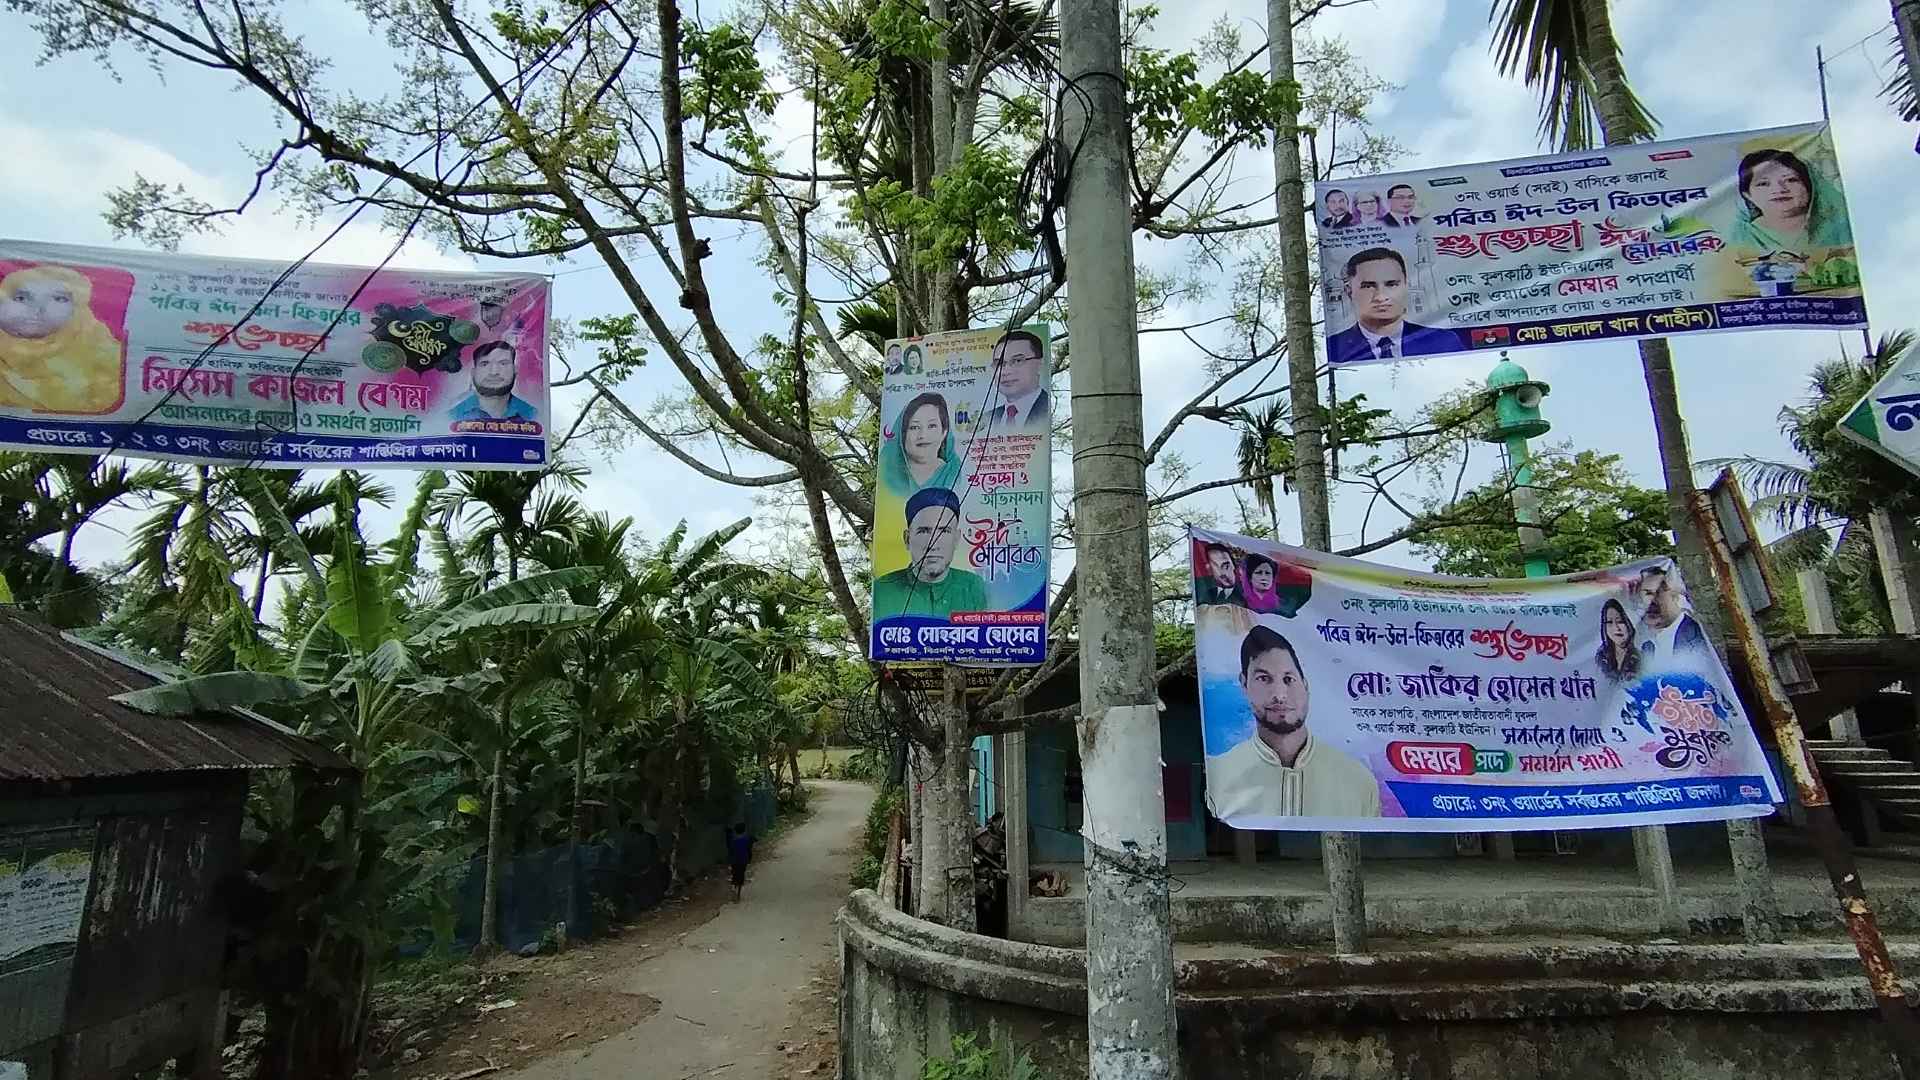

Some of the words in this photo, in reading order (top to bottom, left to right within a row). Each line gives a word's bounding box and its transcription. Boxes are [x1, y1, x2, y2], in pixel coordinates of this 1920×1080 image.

[1455, 191, 1481, 203] ৩নং
[1486, 183, 1521, 200] ওয়ার্ড
[1525, 179, 1569, 197] (সরই)
[1625, 168, 1669, 182] জানাই
[1433, 207, 1497, 228] পবিত্র
[1608, 187, 1709, 211] ফিতরের
[1433, 219, 1585, 260] শুভেচ্ছা
[1621, 236, 1727, 265] মোবারক
[1445, 273, 1476, 288] ৩নং
[1478, 264, 1534, 286] কুলকাঠি
[1537, 257, 1616, 278] ইউনিয়নের
[149, 293, 201, 314] পবিত্র
[1448, 292, 1482, 307] ৩নং
[1488, 280, 1553, 302] ওয়ার্ডের
[1558, 274, 1619, 297] মেম্বার
[1495, 303, 1558, 320] আপনাদের
[1562, 299, 1595, 314] দোয়া
[1600, 299, 1612, 309] ও
[1615, 291, 1655, 307] সমর্থন
[1516, 326, 1549, 342] মোঃ
[1550, 320, 1604, 338] জালাল
[1608, 317, 1640, 333] খান
[1645, 307, 1714, 335] (শাহীন)
[246, 371, 346, 406] কাজল
[357, 382, 431, 414] বেগম
[299, 415, 313, 428] ও
[316, 410, 367, 433] সমর্থন
[152, 434, 170, 448] ও
[174, 435, 212, 454] ৩নং
[967, 471, 1015, 494] শুভেচ্ছা
[980, 485, 1043, 510] অভিনন্দন
[968, 541, 1044, 581] মোবারক
[1341, 598, 1365, 612] ৩নং
[1368, 596, 1409, 615] কুলকাঠি
[880, 626, 912, 647] মোঃ
[917, 626, 981, 647] সোহরাব
[986, 626, 1041, 647] হোসেন
[1316, 618, 1351, 645] পবিত্র
[1469, 619, 1569, 662] শুভেচ্ছা
[1395, 665, 1482, 702] জাকির
[1487, 675, 1556, 703] হোসেন
[1501, 724, 1566, 749] সকলের
[1569, 724, 1607, 747] দোয়া
[1611, 726, 1628, 743] ও
[1400, 746, 1462, 773] মেম্বার
[1474, 751, 1506, 771] পদে
[1518, 748, 1575, 773] সমর্থন
[1480, 796, 1513, 813] ৩নং
[1511, 789, 1564, 811] ওয়ার্ডের
